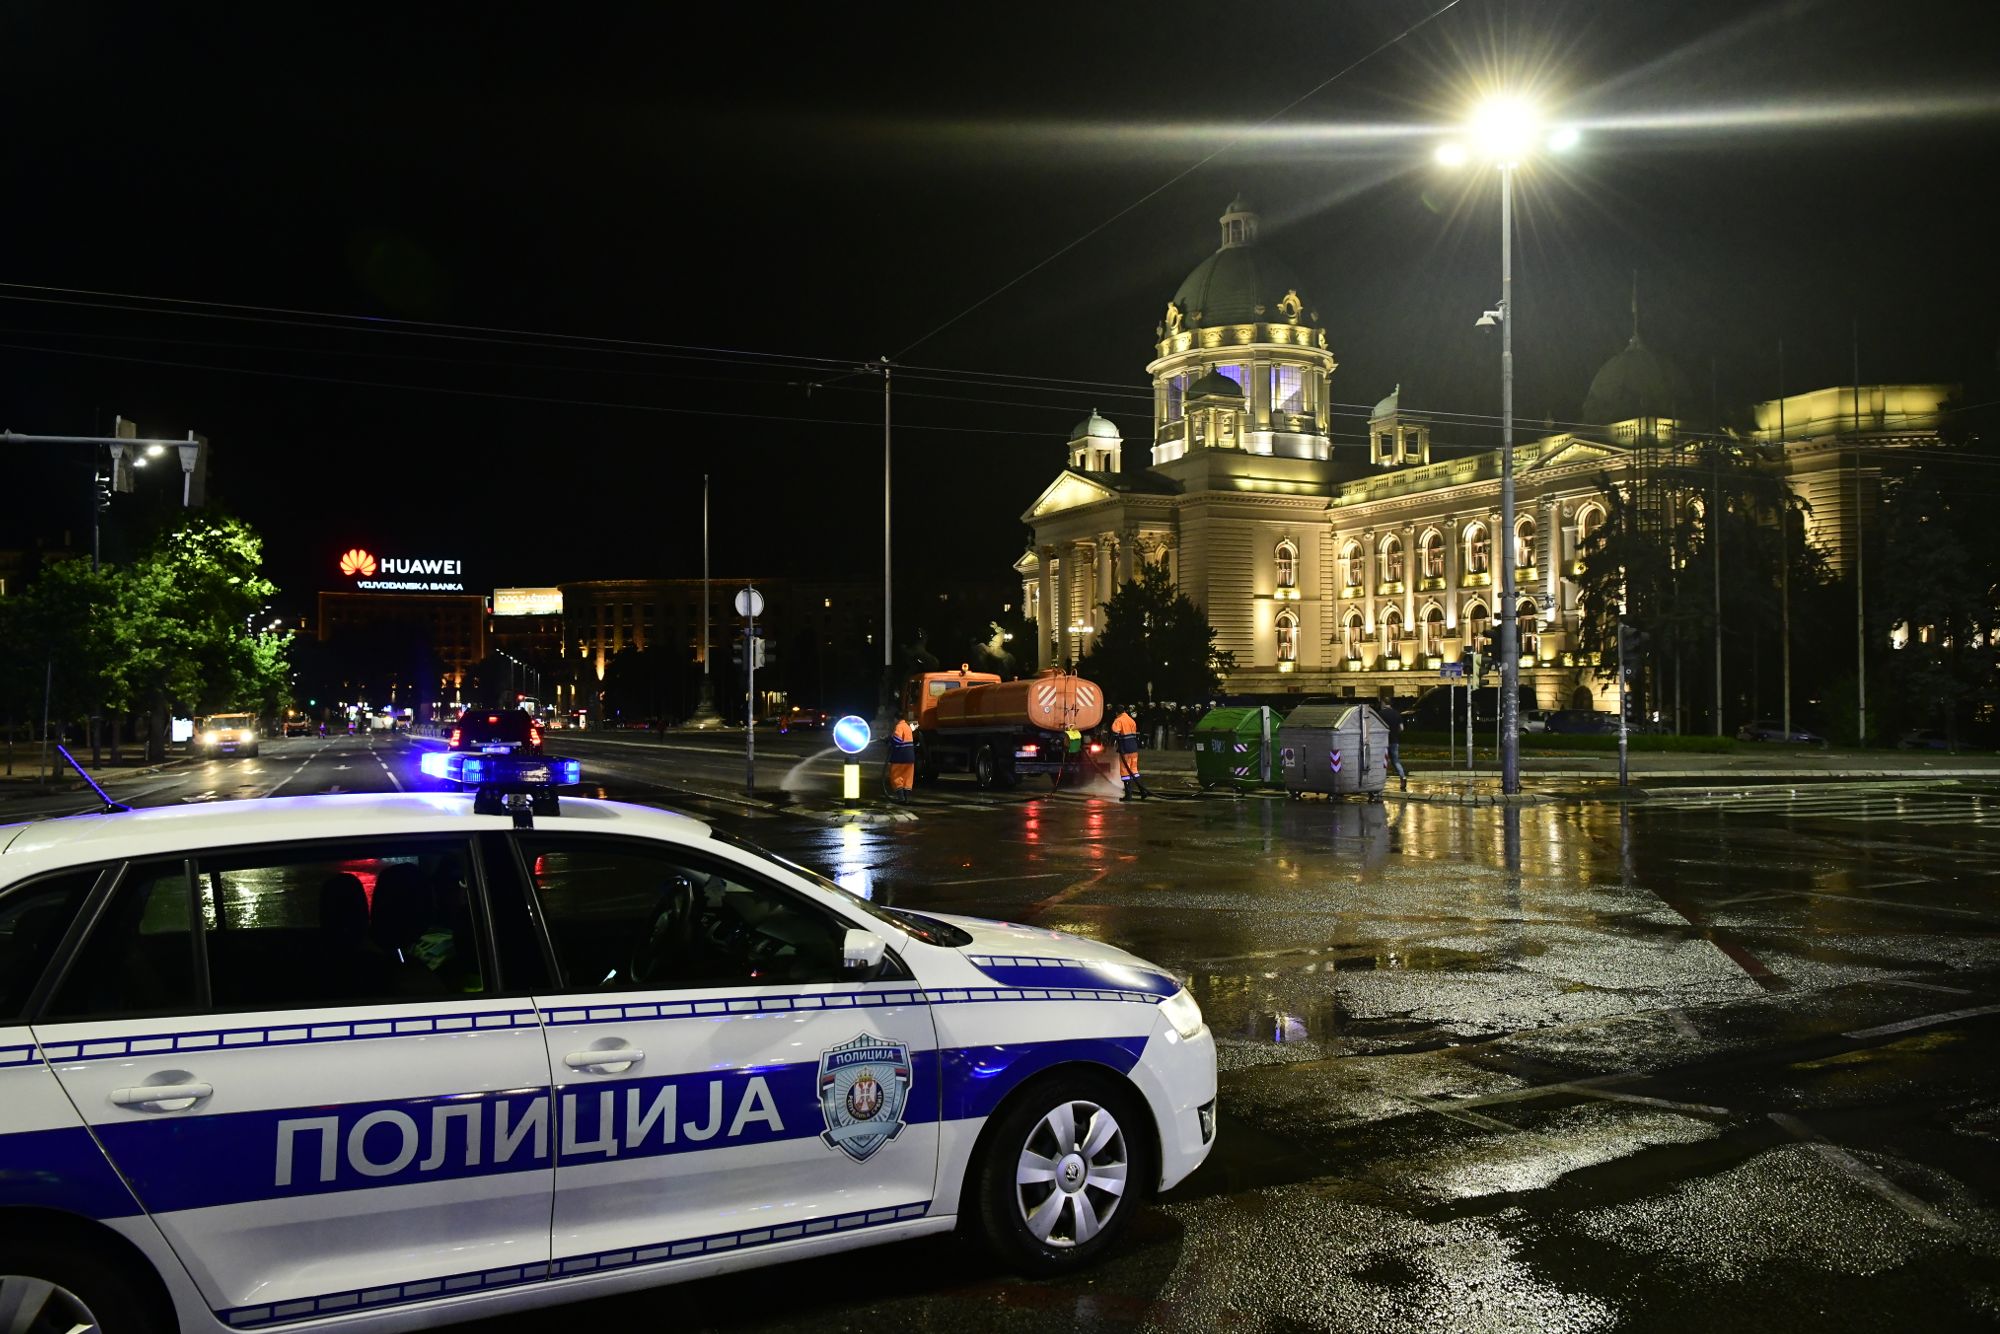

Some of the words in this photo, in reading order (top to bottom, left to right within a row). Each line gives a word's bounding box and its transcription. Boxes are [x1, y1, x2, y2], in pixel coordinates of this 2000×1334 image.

[381, 558, 461, 575] HUAWEI
[430, 582, 464, 591] BANKA
[836, 1050, 894, 1065] ПОЛИЦИЈА
[274, 1076, 785, 1186] ПОЛИЦИЈА
